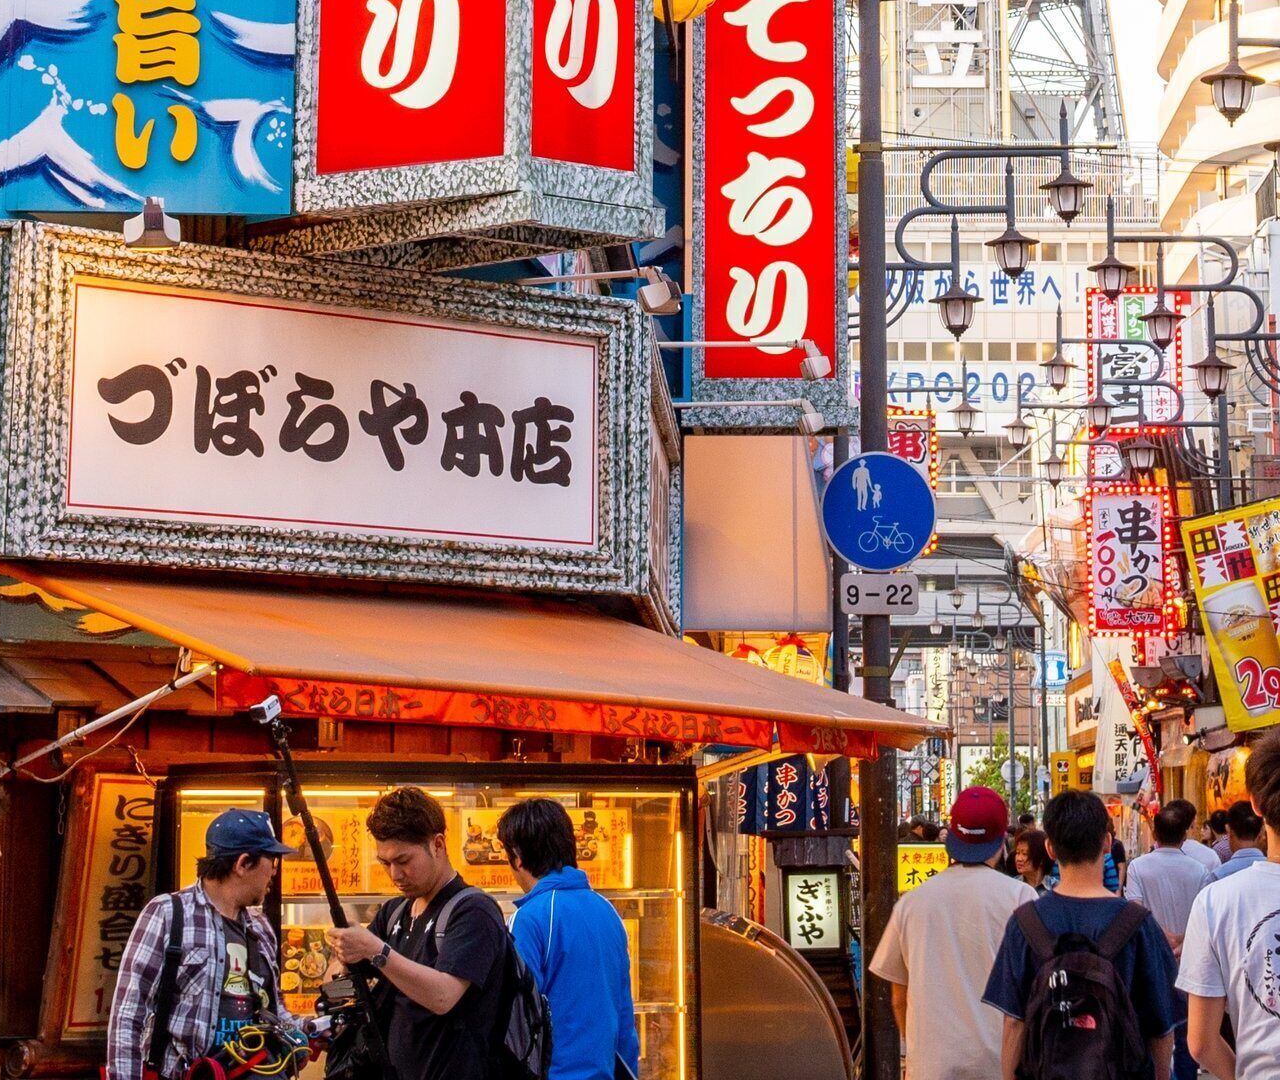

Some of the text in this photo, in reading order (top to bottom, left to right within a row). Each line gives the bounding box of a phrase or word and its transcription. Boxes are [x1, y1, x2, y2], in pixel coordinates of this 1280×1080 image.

[96, 355, 576, 488] づぼらや本店
[1114, 499, 1160, 598] 串かつ
[775, 762, 798, 827] 串かつ
